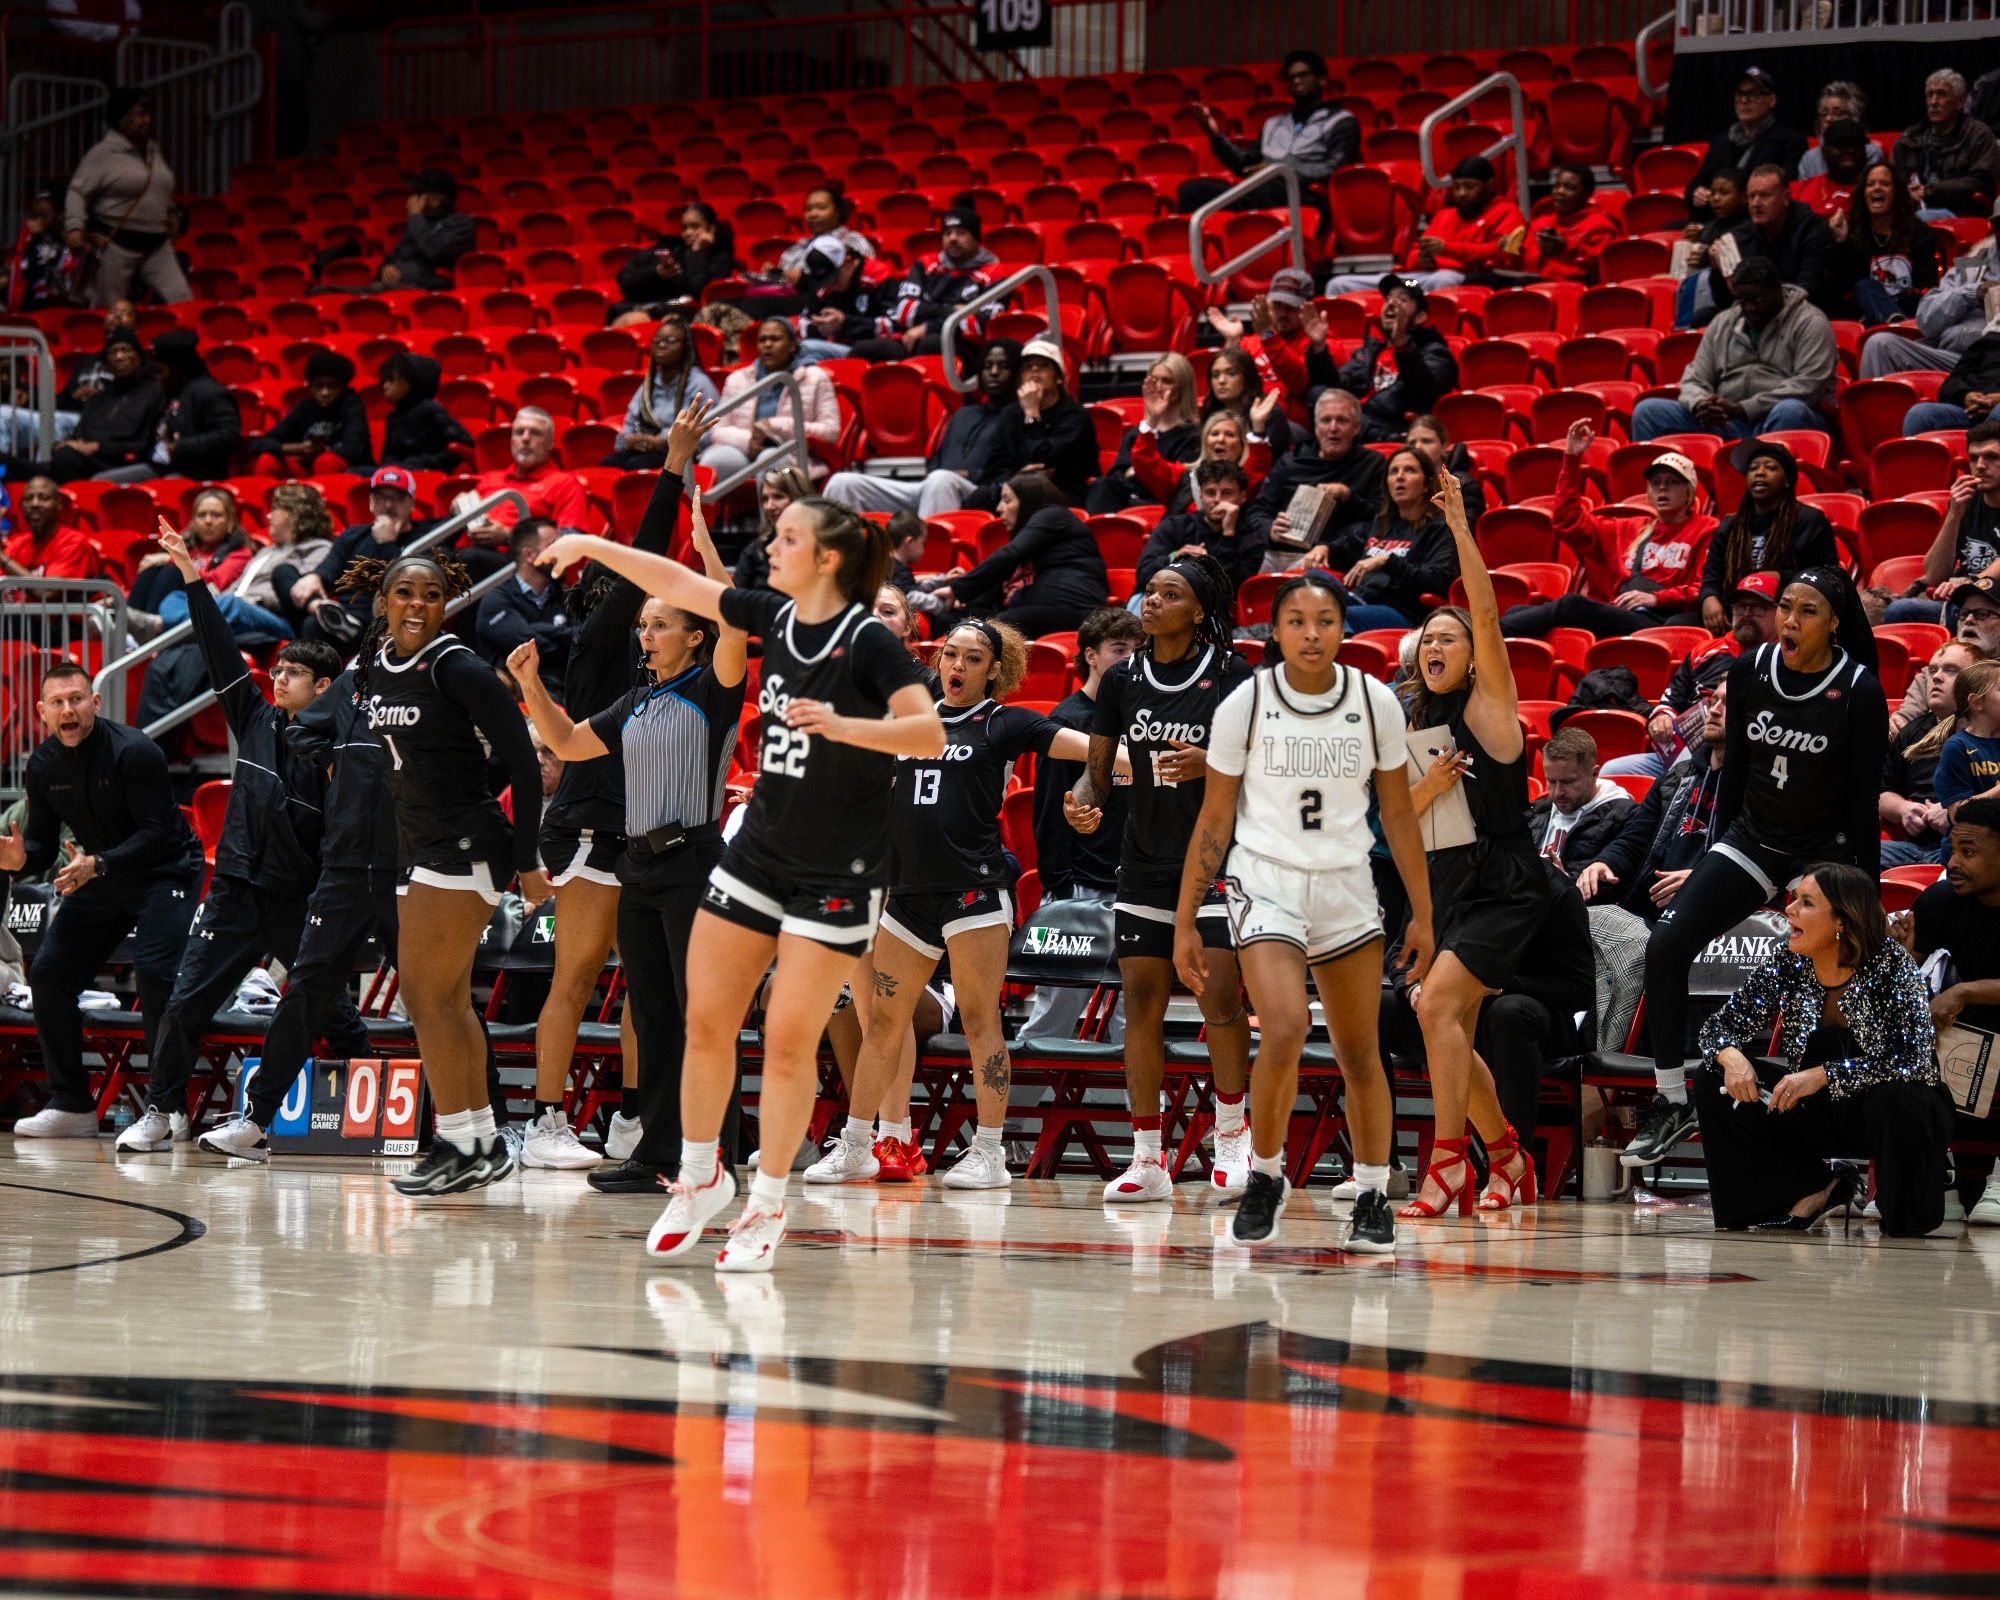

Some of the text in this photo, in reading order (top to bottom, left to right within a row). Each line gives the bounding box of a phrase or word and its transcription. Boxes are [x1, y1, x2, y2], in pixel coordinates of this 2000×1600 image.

[980, 0, 1041, 33] 109
[367, 694, 421, 730] Semo
[758, 673, 834, 721] Se
[1129, 708, 1206, 743] Semo
[1746, 710, 1828, 754] Semo
[762, 725, 811, 779] 22
[1263, 736, 1362, 778] LIONS
[1970, 760, 2000, 777] IND
[913, 768, 942, 805] 13
[1770, 755, 1789, 790] 4
[1300, 788, 1323, 831] 2
[9, 902, 46, 922] ANK
[1042, 933, 1096, 952] BANK
[1704, 934, 1776, 957] BANK
[1703, 956, 1769, 964] OF MISSOUR
[327, 1069, 338, 1098] 1
[311, 1113, 340, 1122] PERIOD
[311, 1121, 339, 1130] GAMES
[385, 1143, 417, 1153] GUEST
